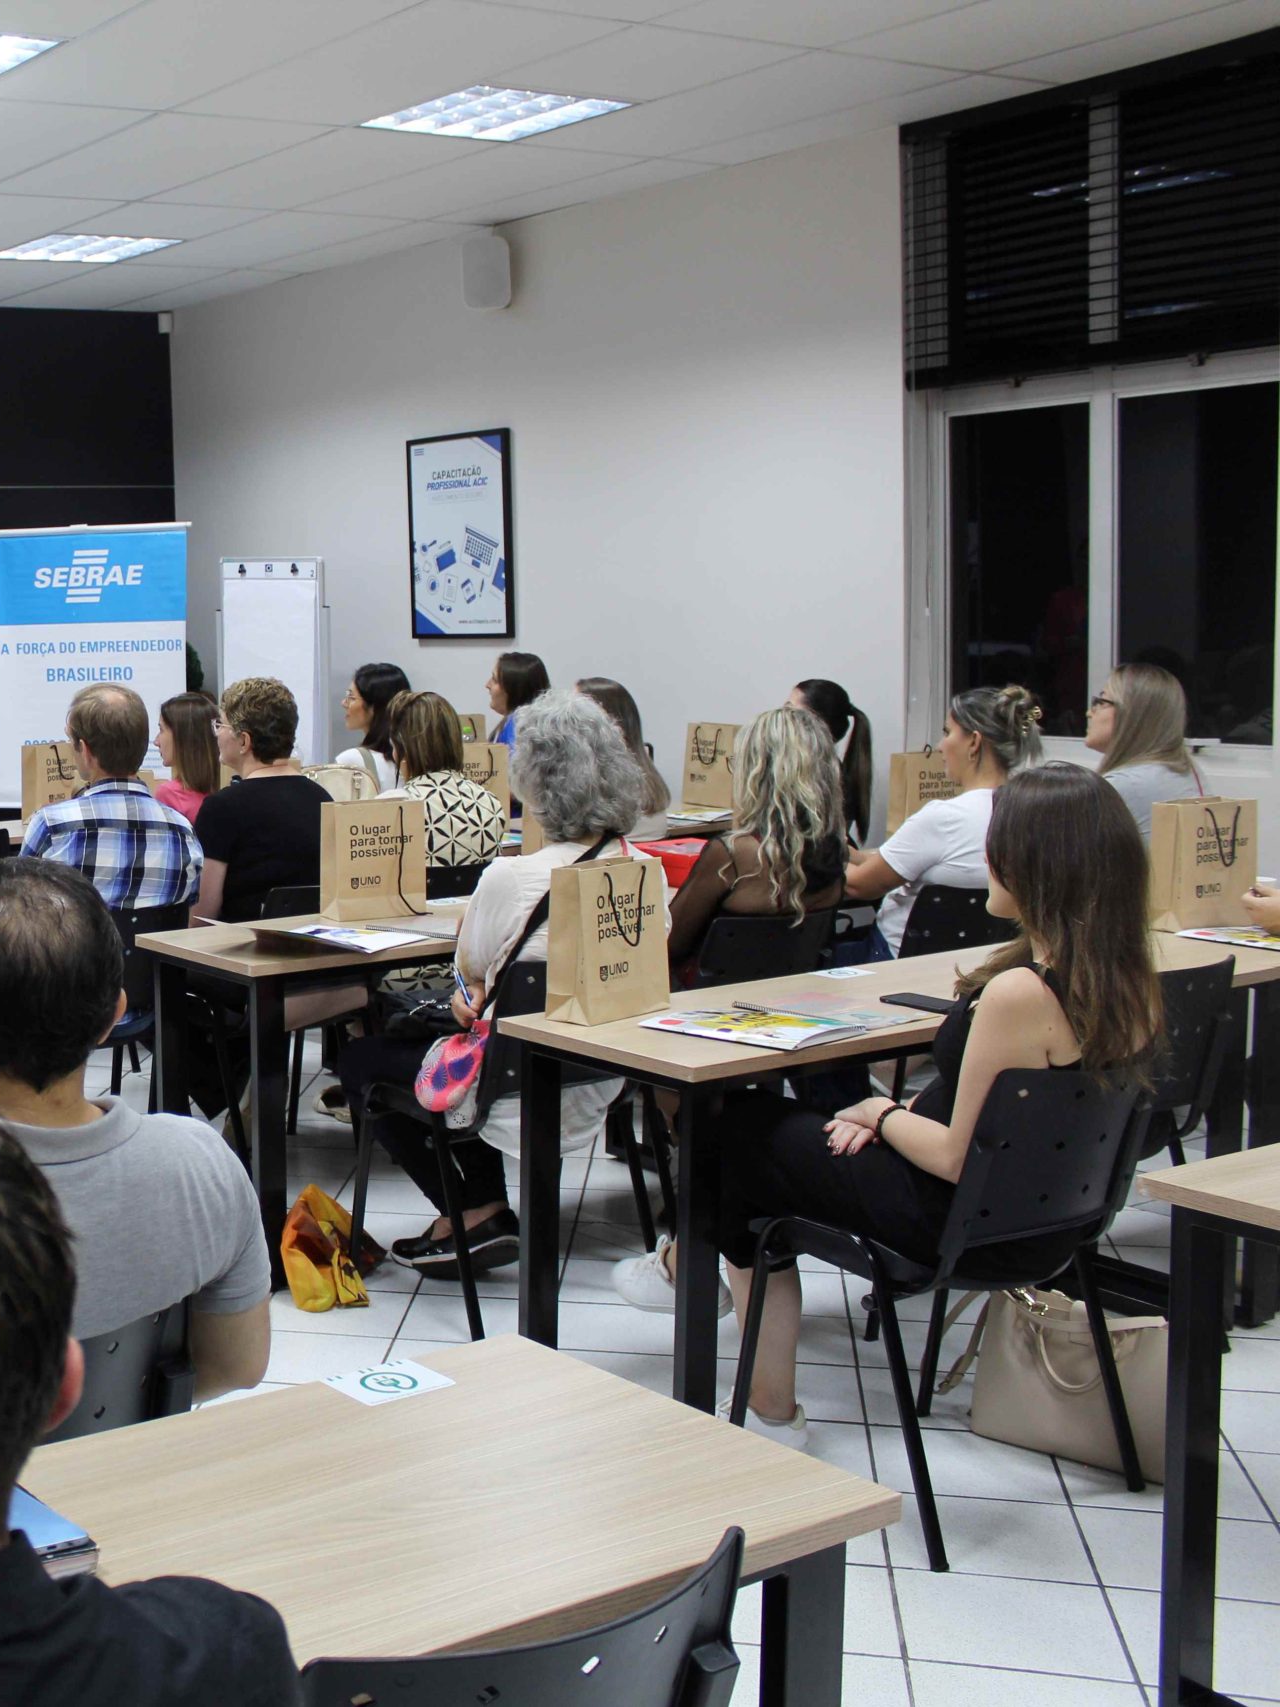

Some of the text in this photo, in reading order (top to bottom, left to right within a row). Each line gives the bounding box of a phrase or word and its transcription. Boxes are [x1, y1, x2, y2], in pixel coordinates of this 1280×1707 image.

[432, 465, 482, 481] CAPACITAÇÃO
[426, 476, 488, 492] PROFISSIONAL ACIC
[34, 565, 143, 588] SEBRAE
[1, 639, 183, 657] A FORÇA DO EMPREENDEDOR
[46, 666, 133, 682] BRASILEIRO
[919, 771, 926, 780] O
[350, 825, 391, 836] O lugar
[1197, 827, 1204, 838] O
[350, 835, 414, 849] para tornar
[1197, 841, 1217, 853] para
[360, 876, 381, 886] UNO
[597, 896, 605, 909] O
[609, 961, 629, 975] UNO
